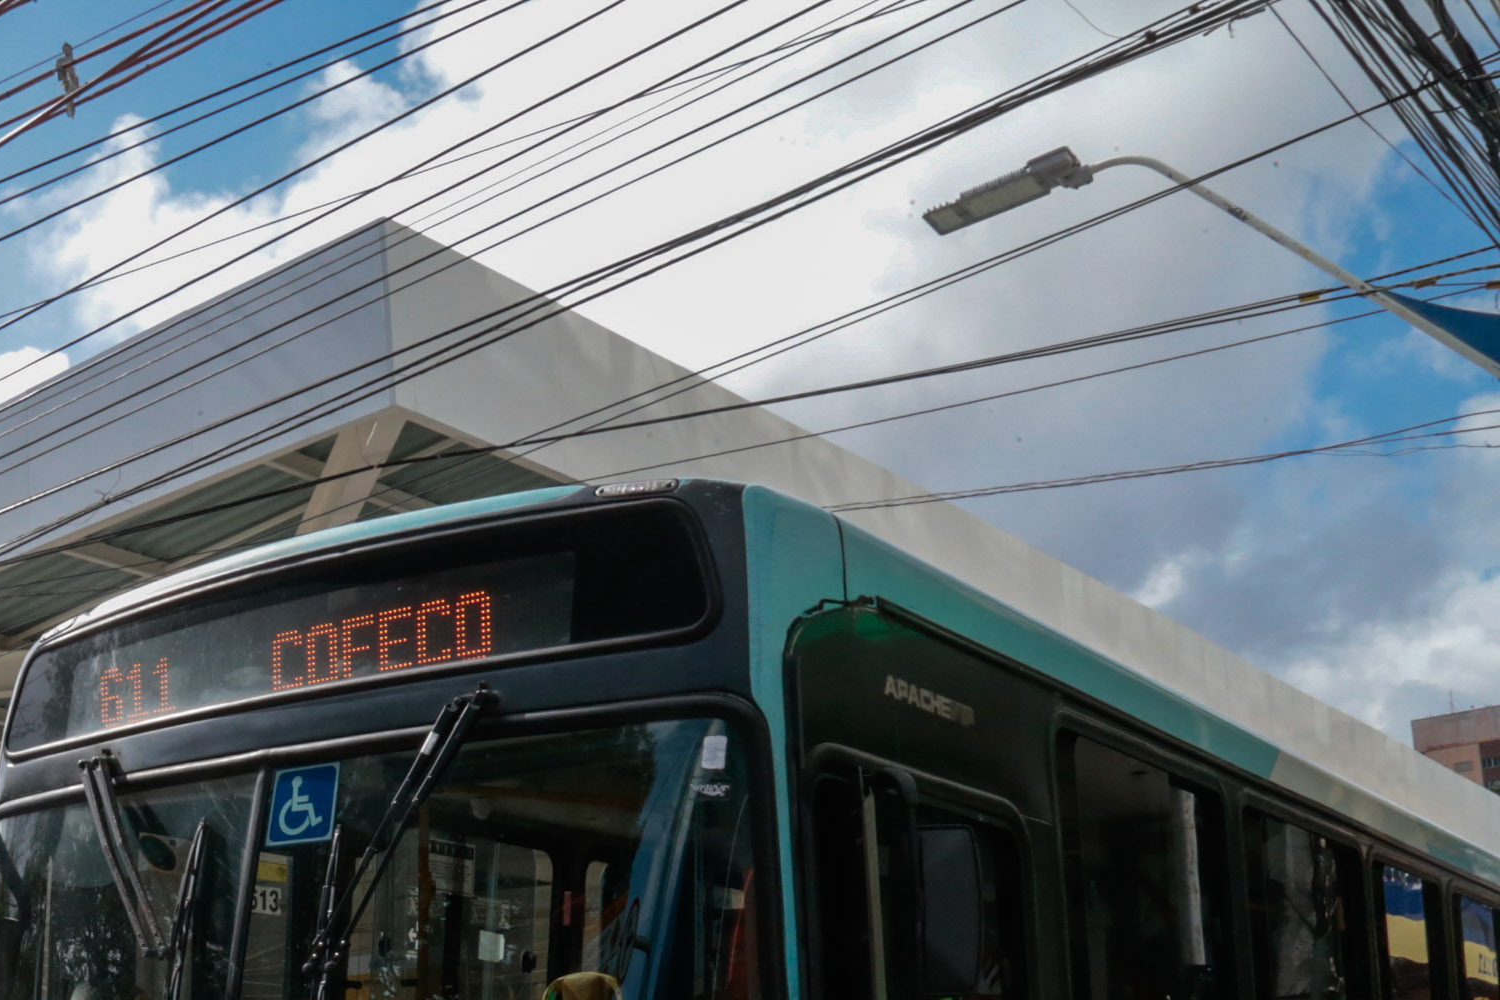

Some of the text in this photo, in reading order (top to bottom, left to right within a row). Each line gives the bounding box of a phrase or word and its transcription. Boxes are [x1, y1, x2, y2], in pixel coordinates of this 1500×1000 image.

[100, 590, 492, 728] 611 COFECO
[884, 674, 952, 720] APACHE
